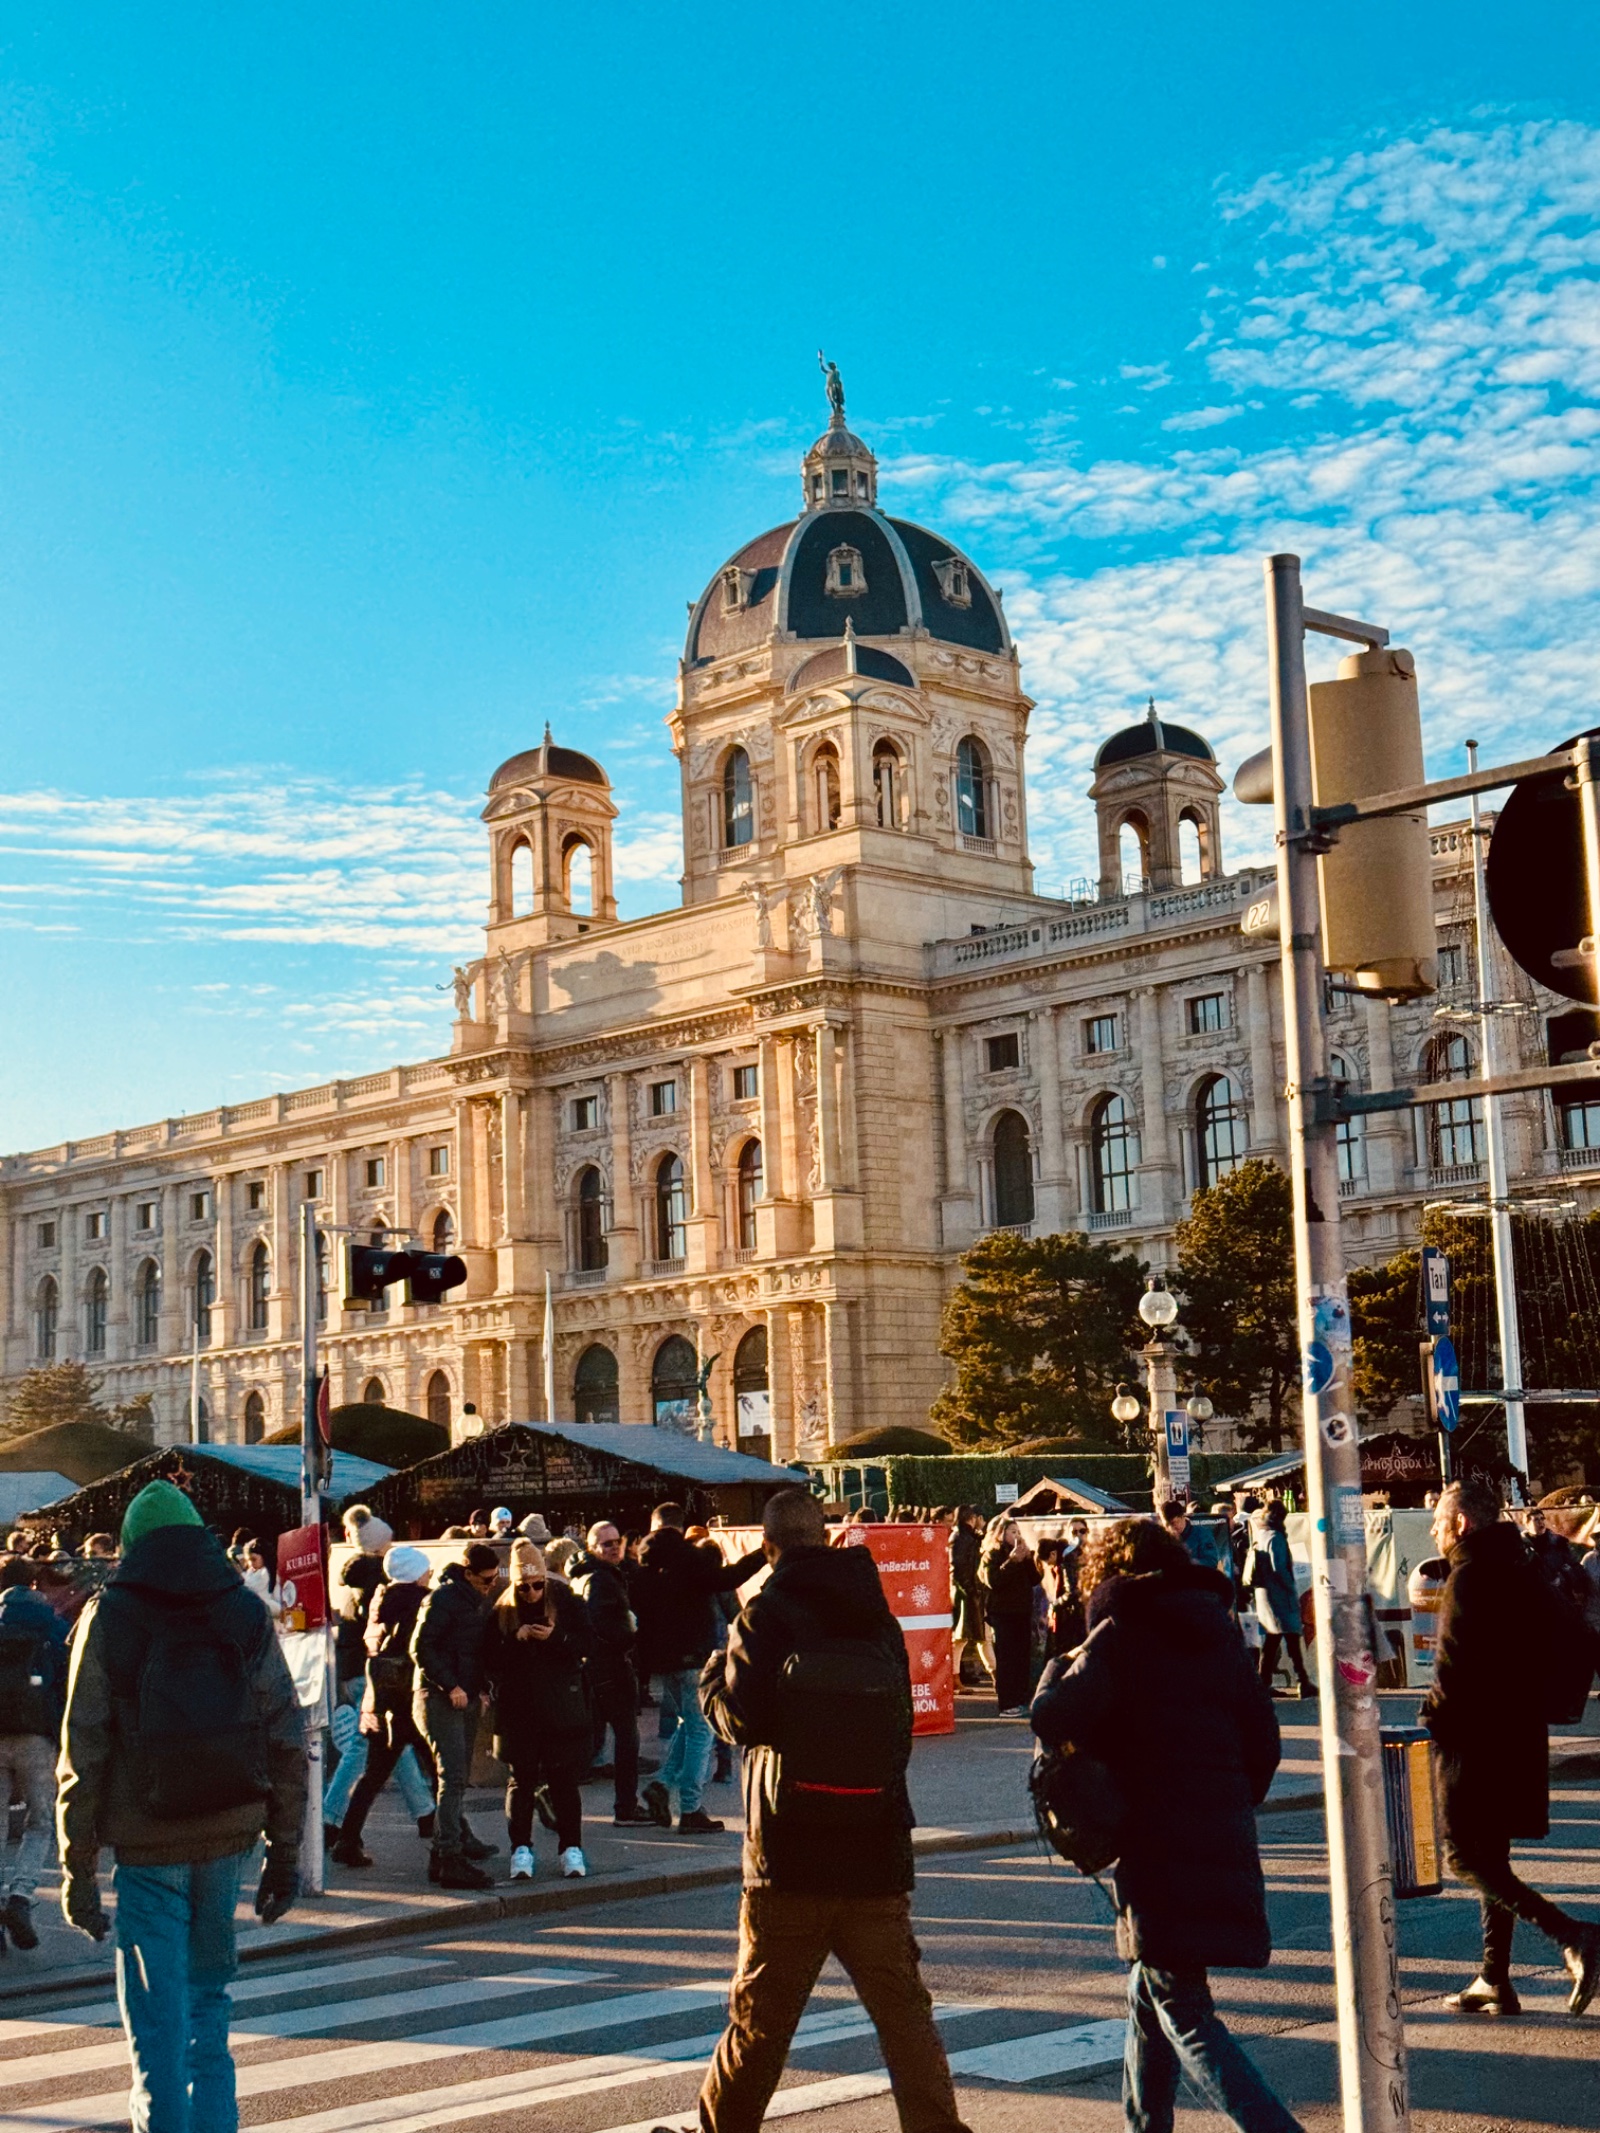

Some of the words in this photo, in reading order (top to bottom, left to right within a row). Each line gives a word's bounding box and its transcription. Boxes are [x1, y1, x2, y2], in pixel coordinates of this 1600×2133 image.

[1250, 903, 1269, 930] 22
[1430, 1267, 1447, 1289] Taxi
[1367, 1458, 1422, 1471] PHOTOBOX
[285, 1552, 318, 1571] KURIER
[911, 1683, 931, 1697] EBE
[912, 1699, 940, 1713] ION.
